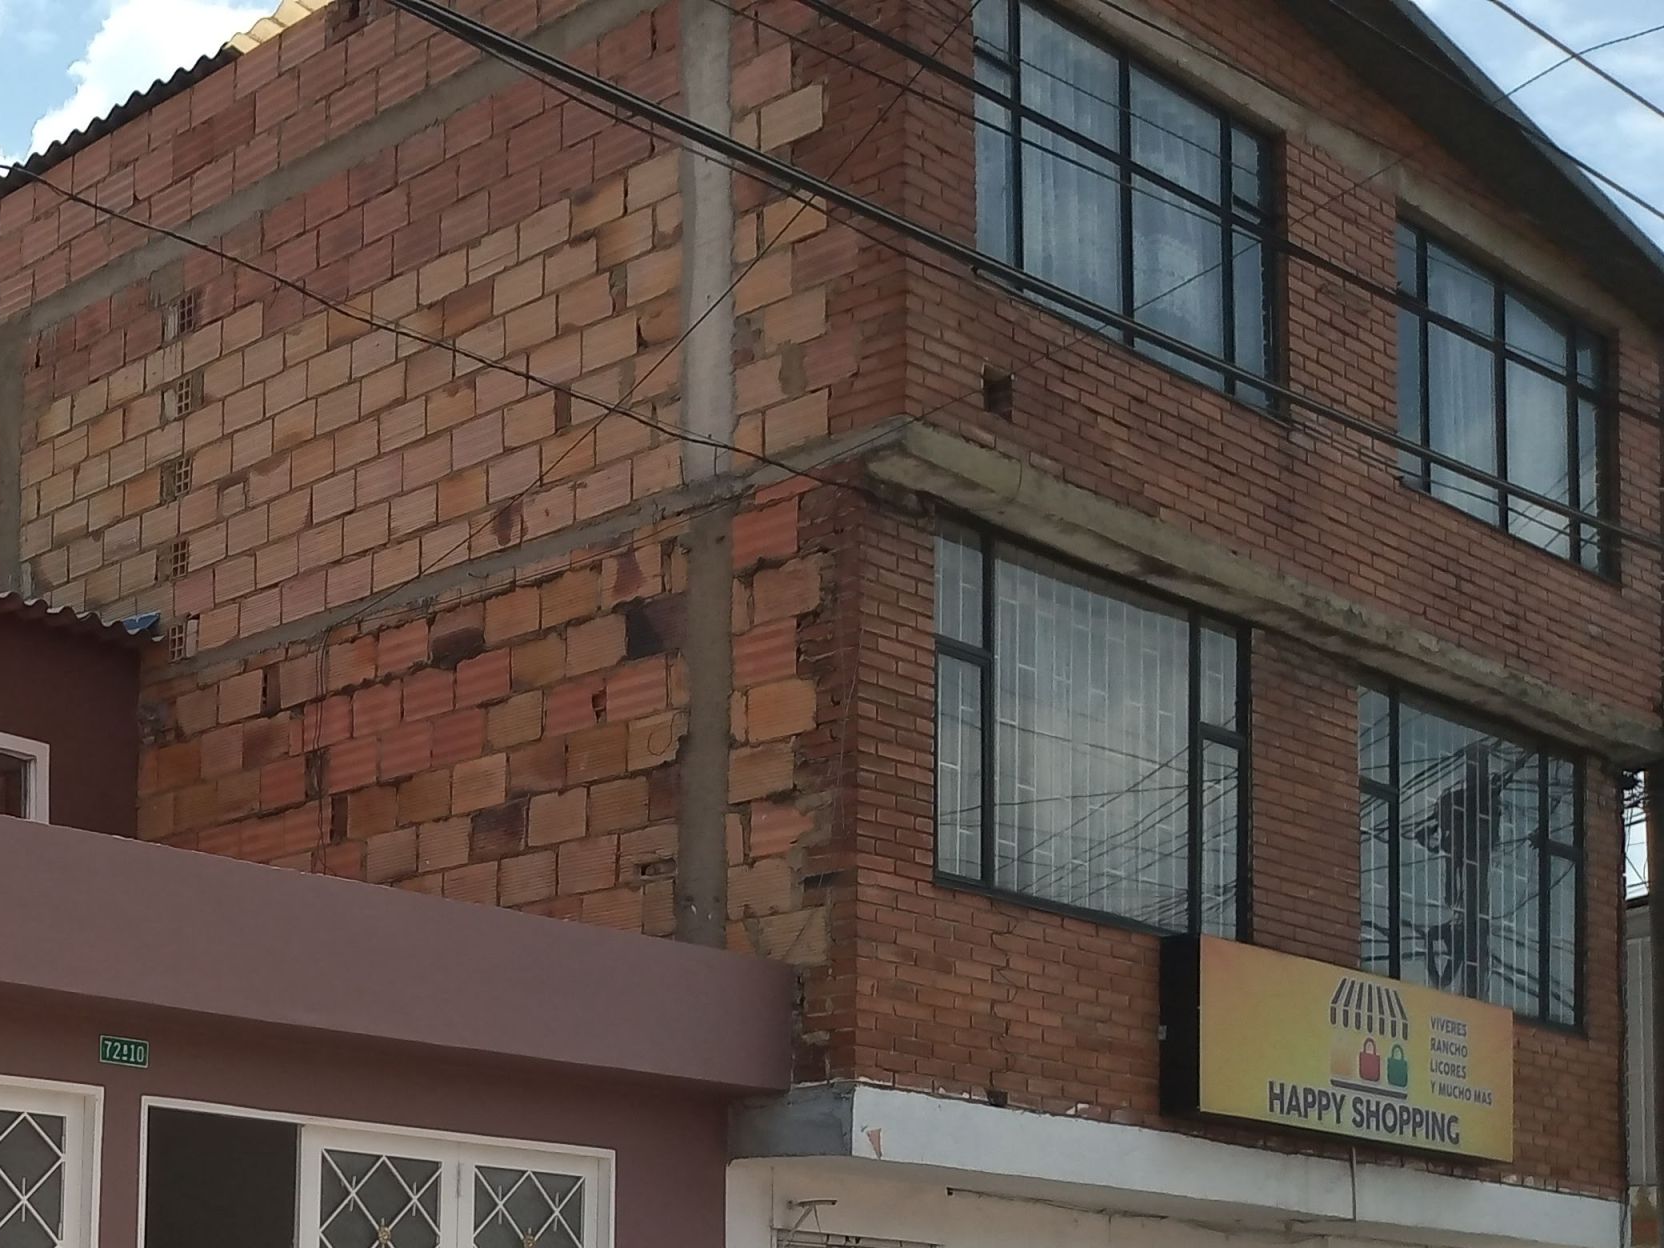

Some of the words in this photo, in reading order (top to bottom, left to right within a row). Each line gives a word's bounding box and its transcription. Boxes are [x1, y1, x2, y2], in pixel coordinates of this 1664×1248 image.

[1431, 1016, 1467, 1037] VIVERES
[1430, 1038, 1468, 1058] RANCHO
[1430, 1059, 1466, 1079] LICORES
[1439, 1082, 1472, 1101] MUCHO
[1474, 1089, 1492, 1106] MAS
[1268, 1081, 1346, 1125] HAPPY
[1352, 1096, 1460, 1145] SHOPPING
